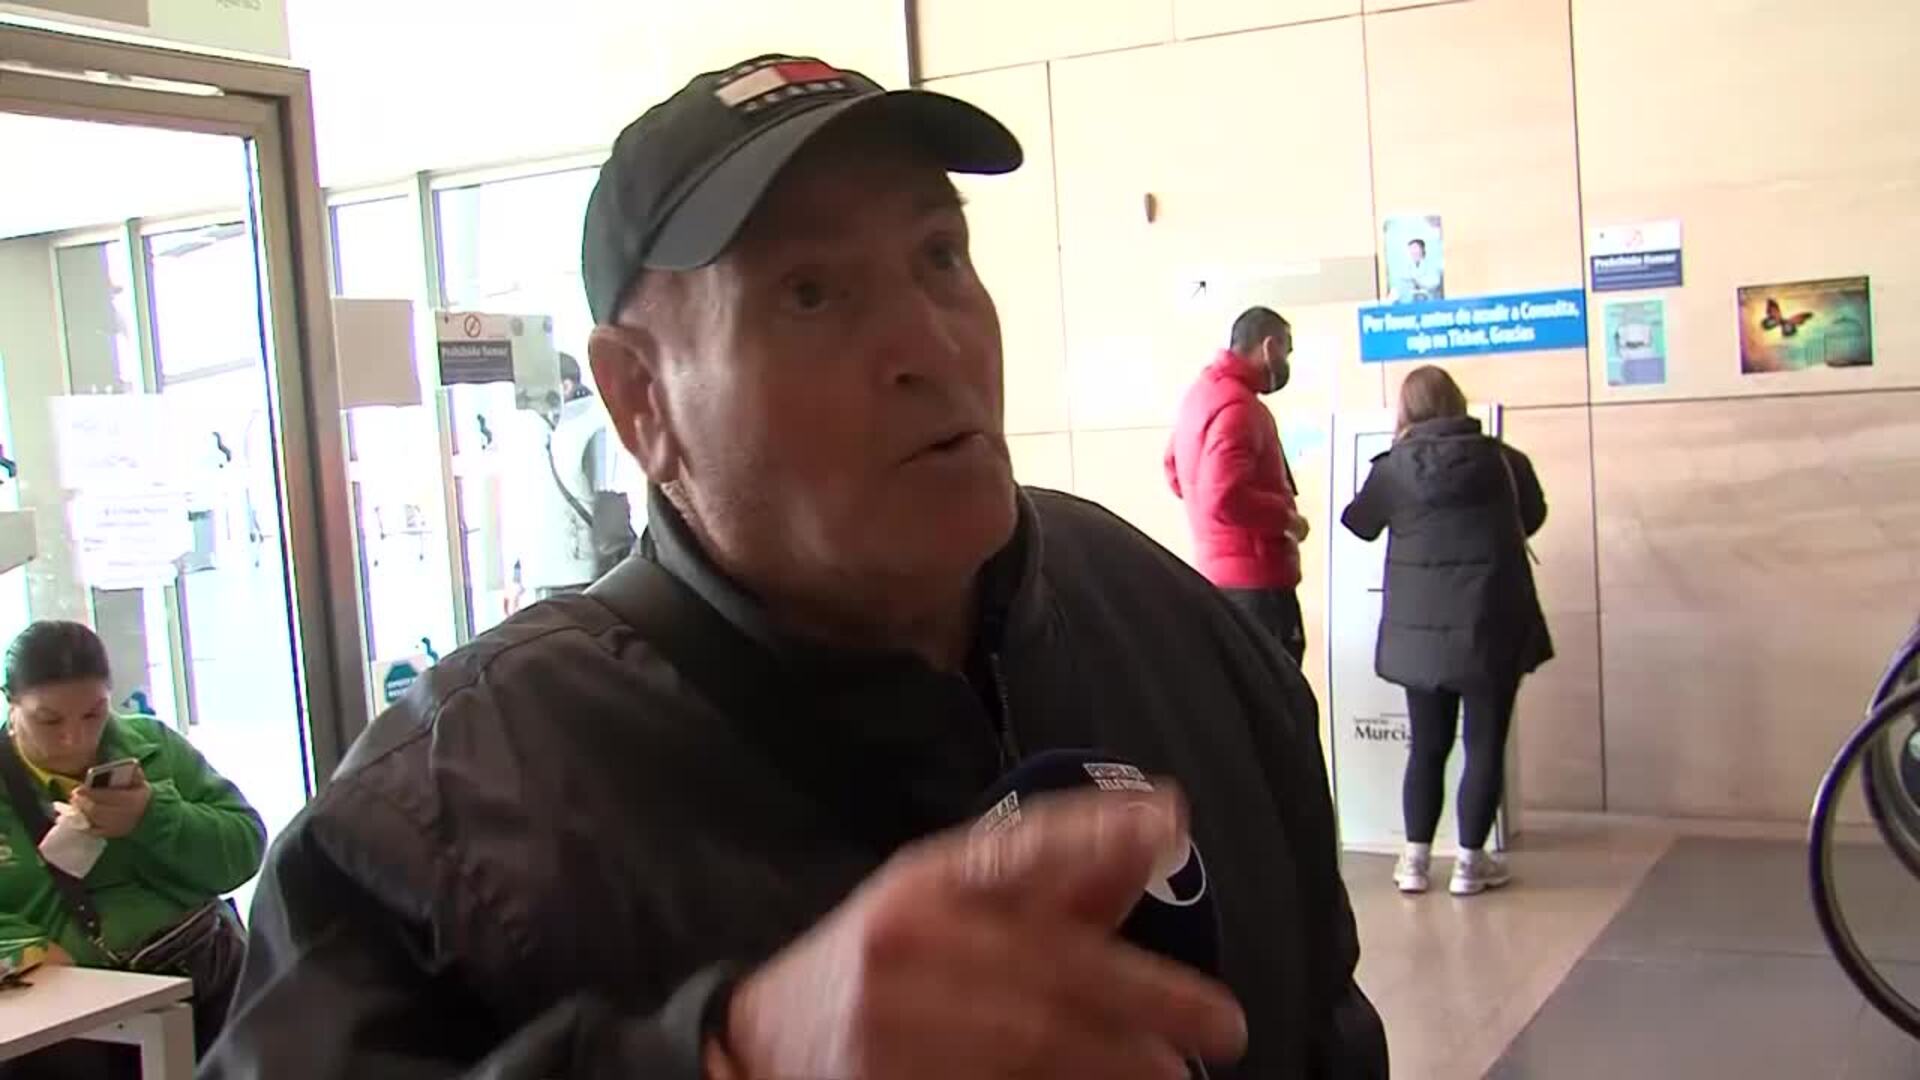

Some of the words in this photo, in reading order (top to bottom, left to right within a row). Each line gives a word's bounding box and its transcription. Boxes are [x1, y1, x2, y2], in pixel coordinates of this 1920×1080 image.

[1361, 313, 1384, 334] Por
[1420, 310, 1454, 330] antes
[1455, 307, 1471, 326] de
[1510, 306, 1520, 321] a
